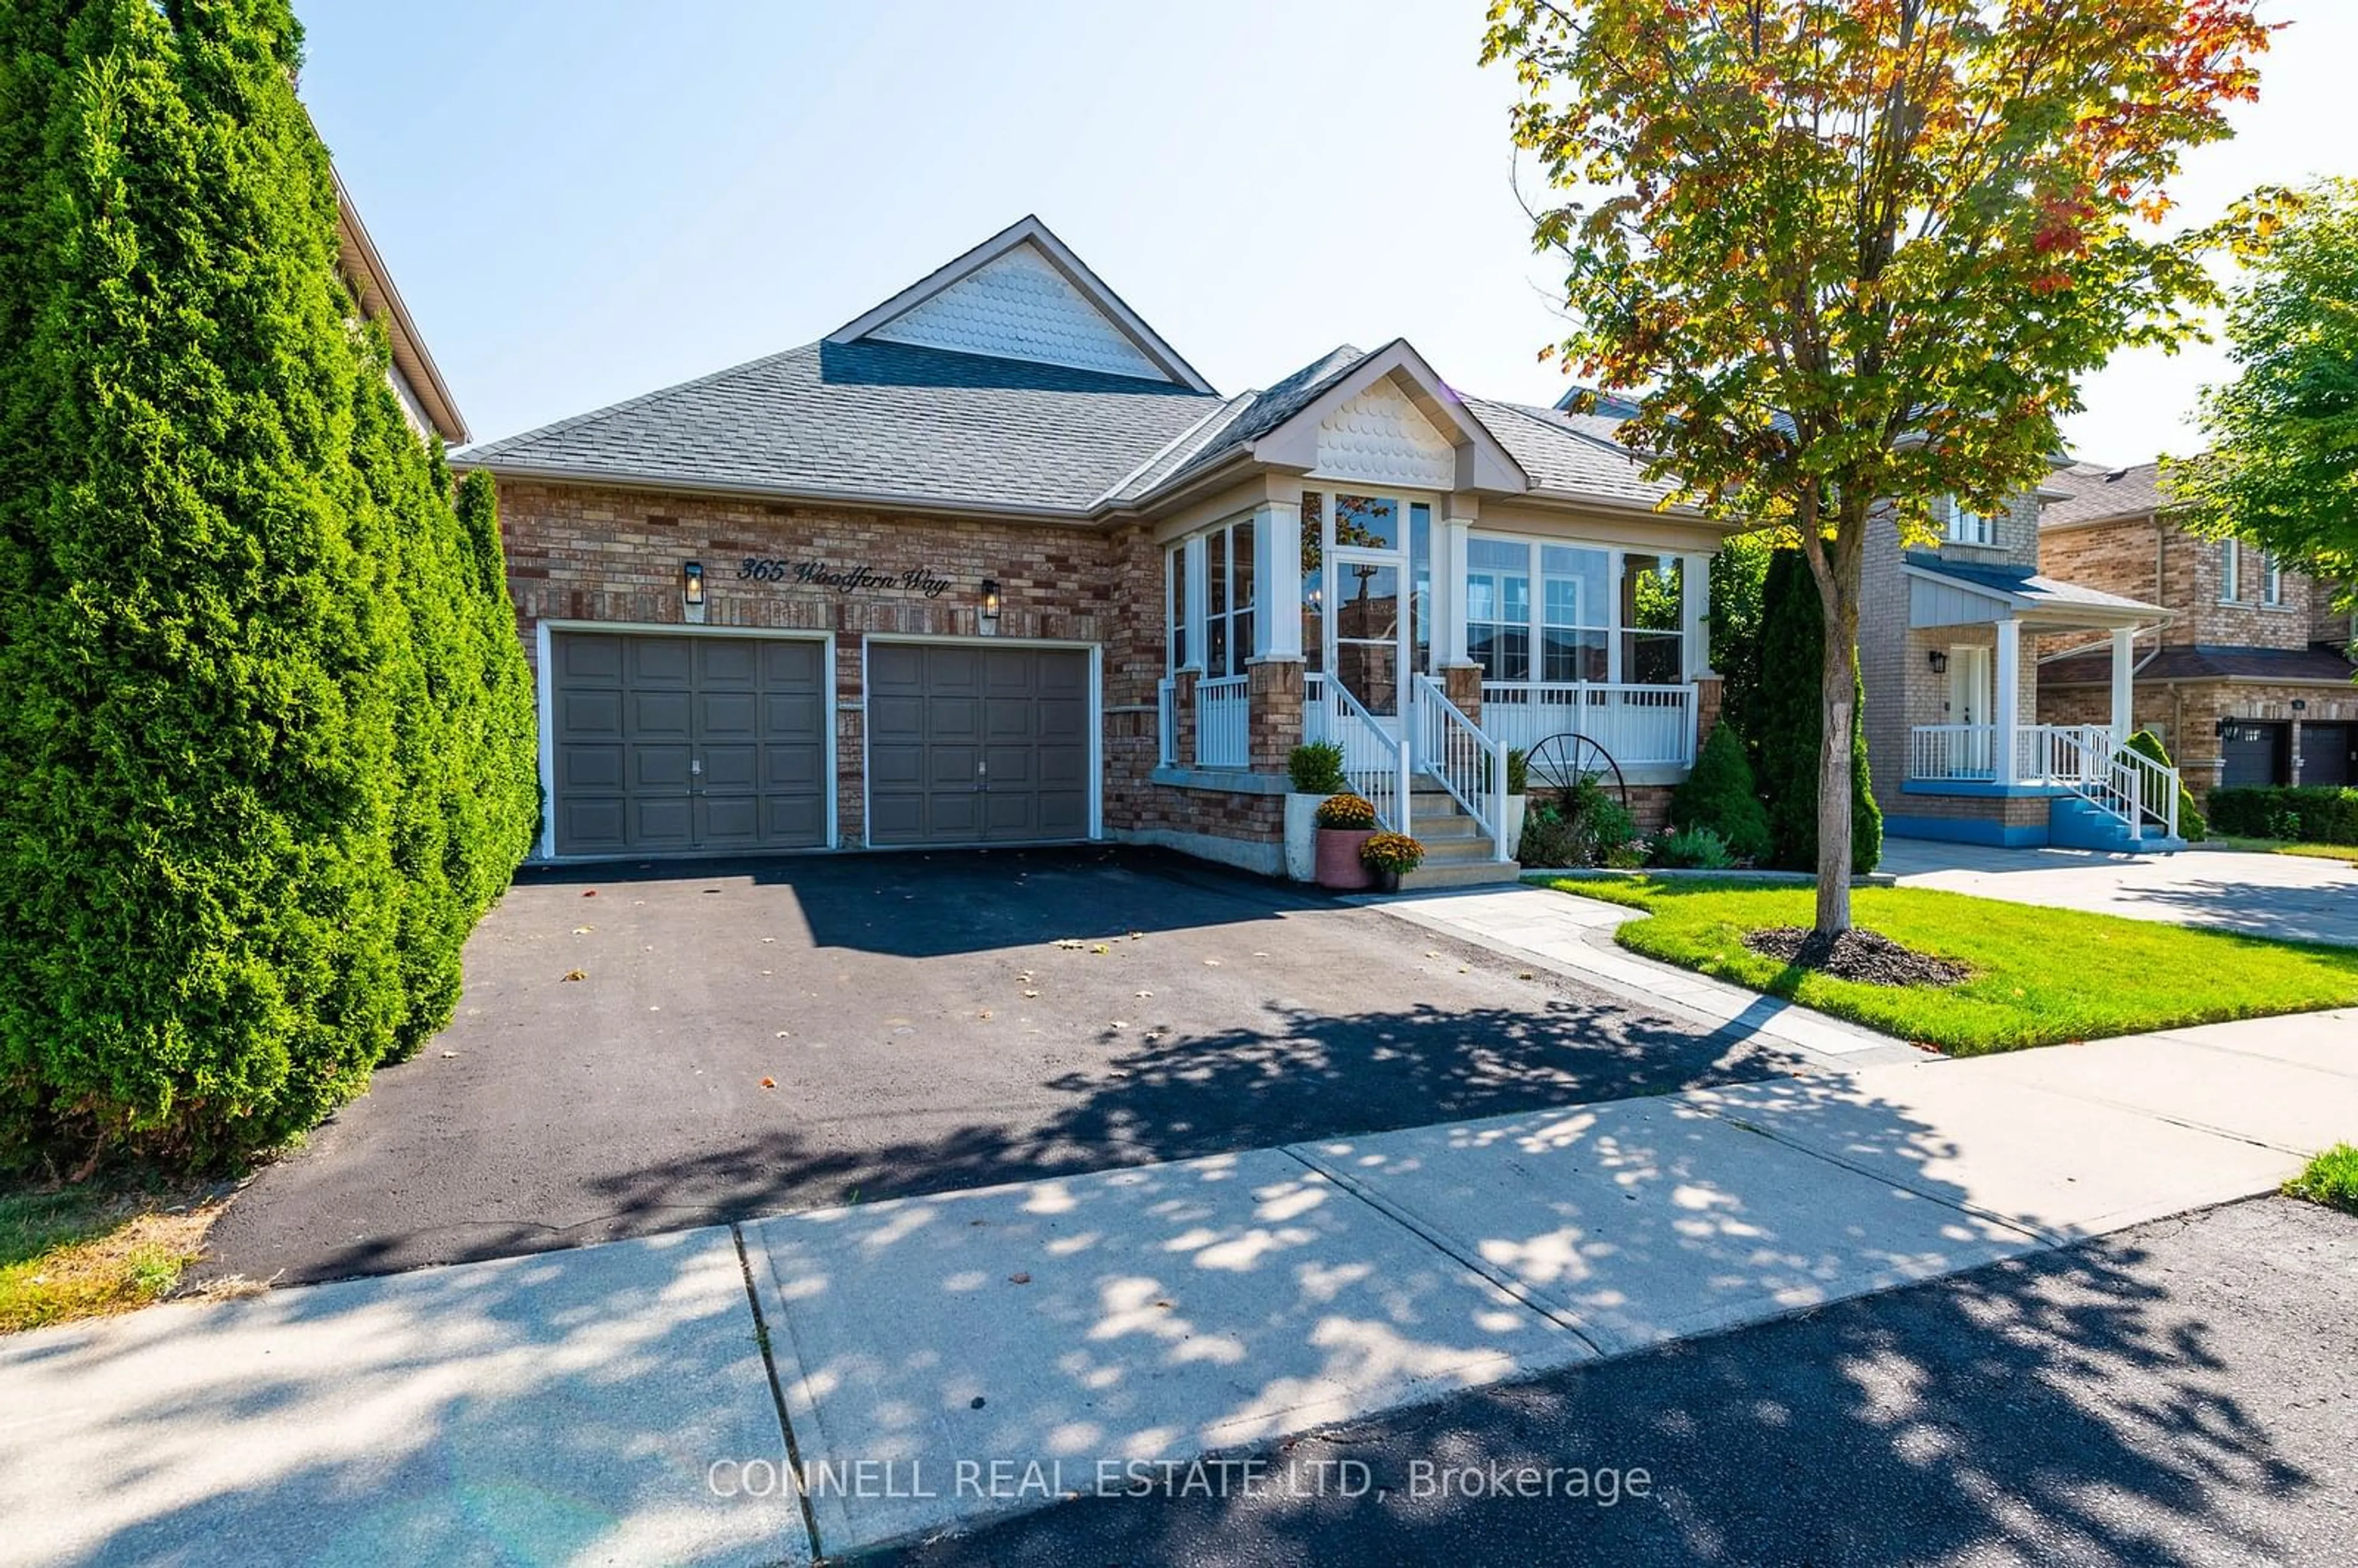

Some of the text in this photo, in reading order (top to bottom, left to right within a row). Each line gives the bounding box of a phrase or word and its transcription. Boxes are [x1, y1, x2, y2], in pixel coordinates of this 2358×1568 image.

[737, 557, 951, 599] 365 Woodfern Way
